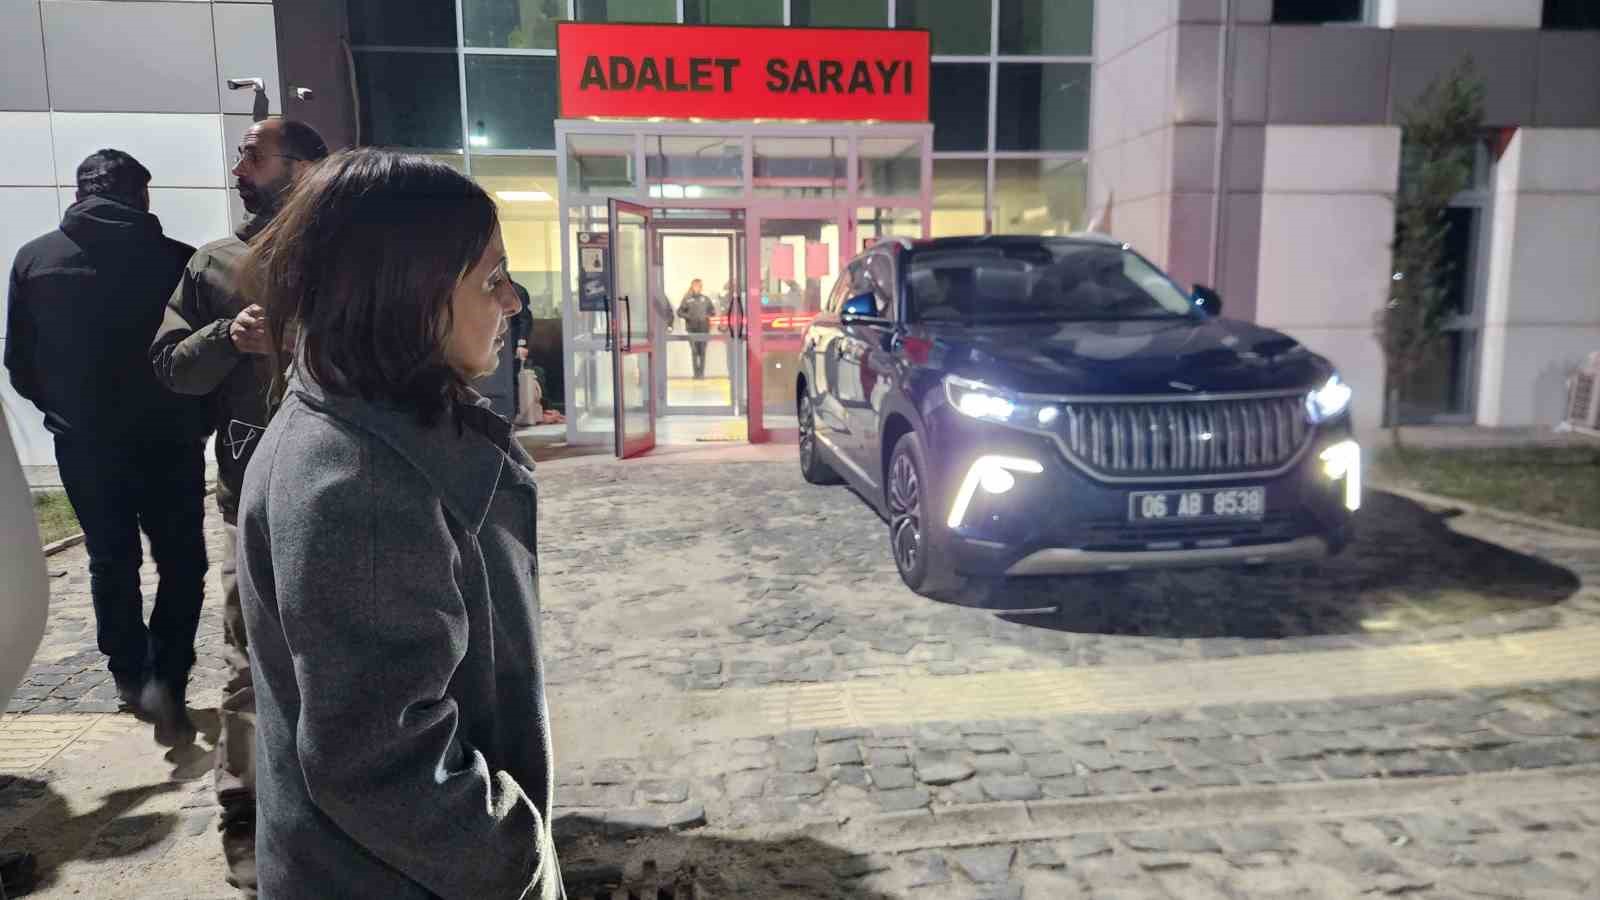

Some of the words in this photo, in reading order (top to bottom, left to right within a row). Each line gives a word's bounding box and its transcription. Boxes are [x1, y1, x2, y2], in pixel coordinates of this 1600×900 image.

[580, 55, 740, 92] ADALET
[766, 58, 913, 95] SARAYI
[1141, 493, 1168, 518] 06
[1177, 491, 1202, 516] AB
